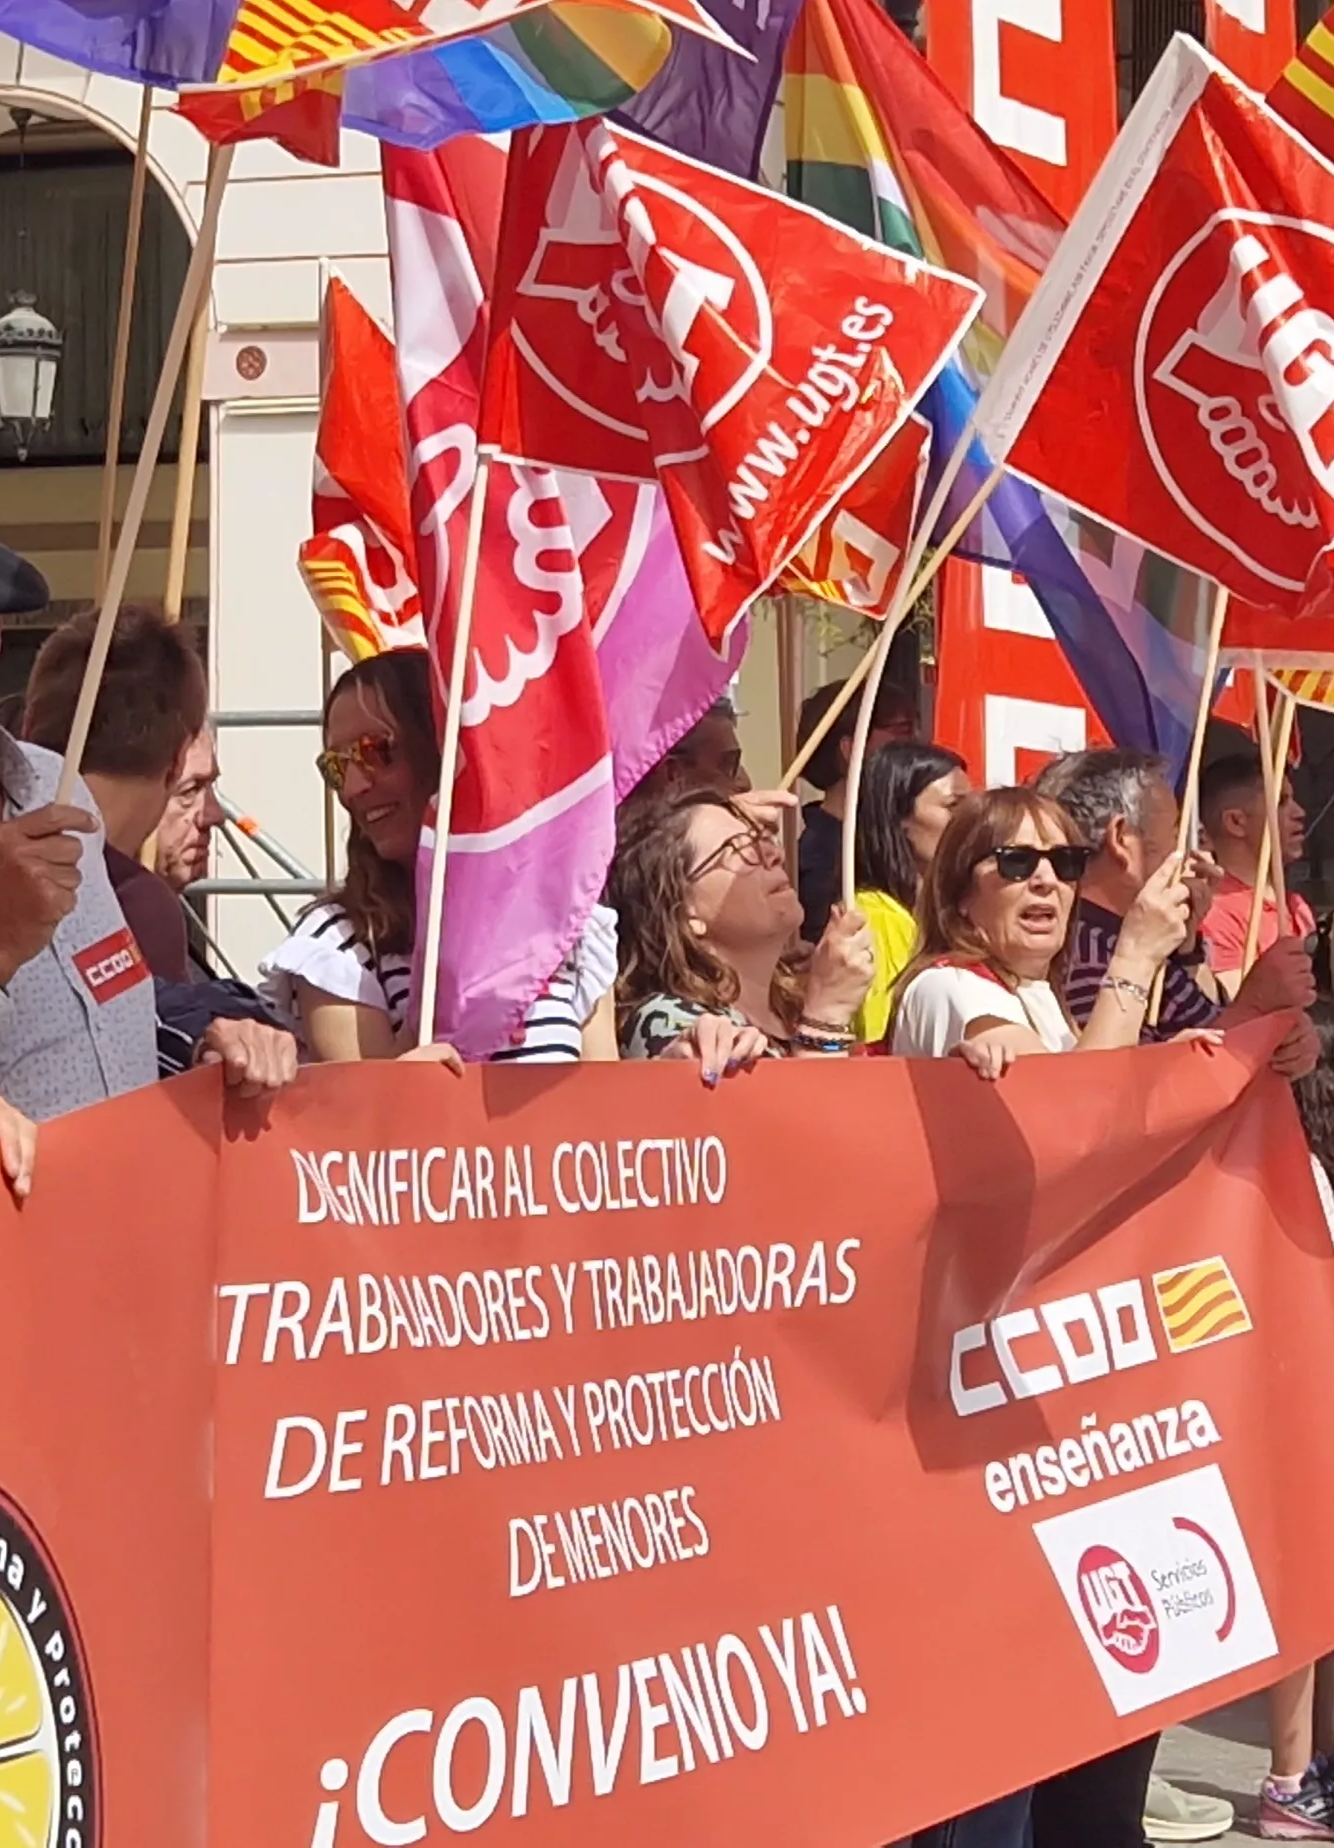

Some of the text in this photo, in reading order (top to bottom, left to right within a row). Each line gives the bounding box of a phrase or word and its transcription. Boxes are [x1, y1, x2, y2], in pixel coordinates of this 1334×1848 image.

[504, 1144, 548, 1217] AL
[552, 1135, 727, 1213] COLECTIVO
[218, 1238, 861, 1366] TRABAJADORES Y TRABAJADORAS
[949, 1278, 1159, 1417] CCOO
[264, 1345, 781, 1500] DE REFORMA Y PROTECCIÓN
[984, 1399, 1223, 1514] enseñanza
[508, 1485, 710, 1599] DE MENORES
[1079, 1559, 1137, 1611] UGT
[758, 1604, 868, 1735] YA!
